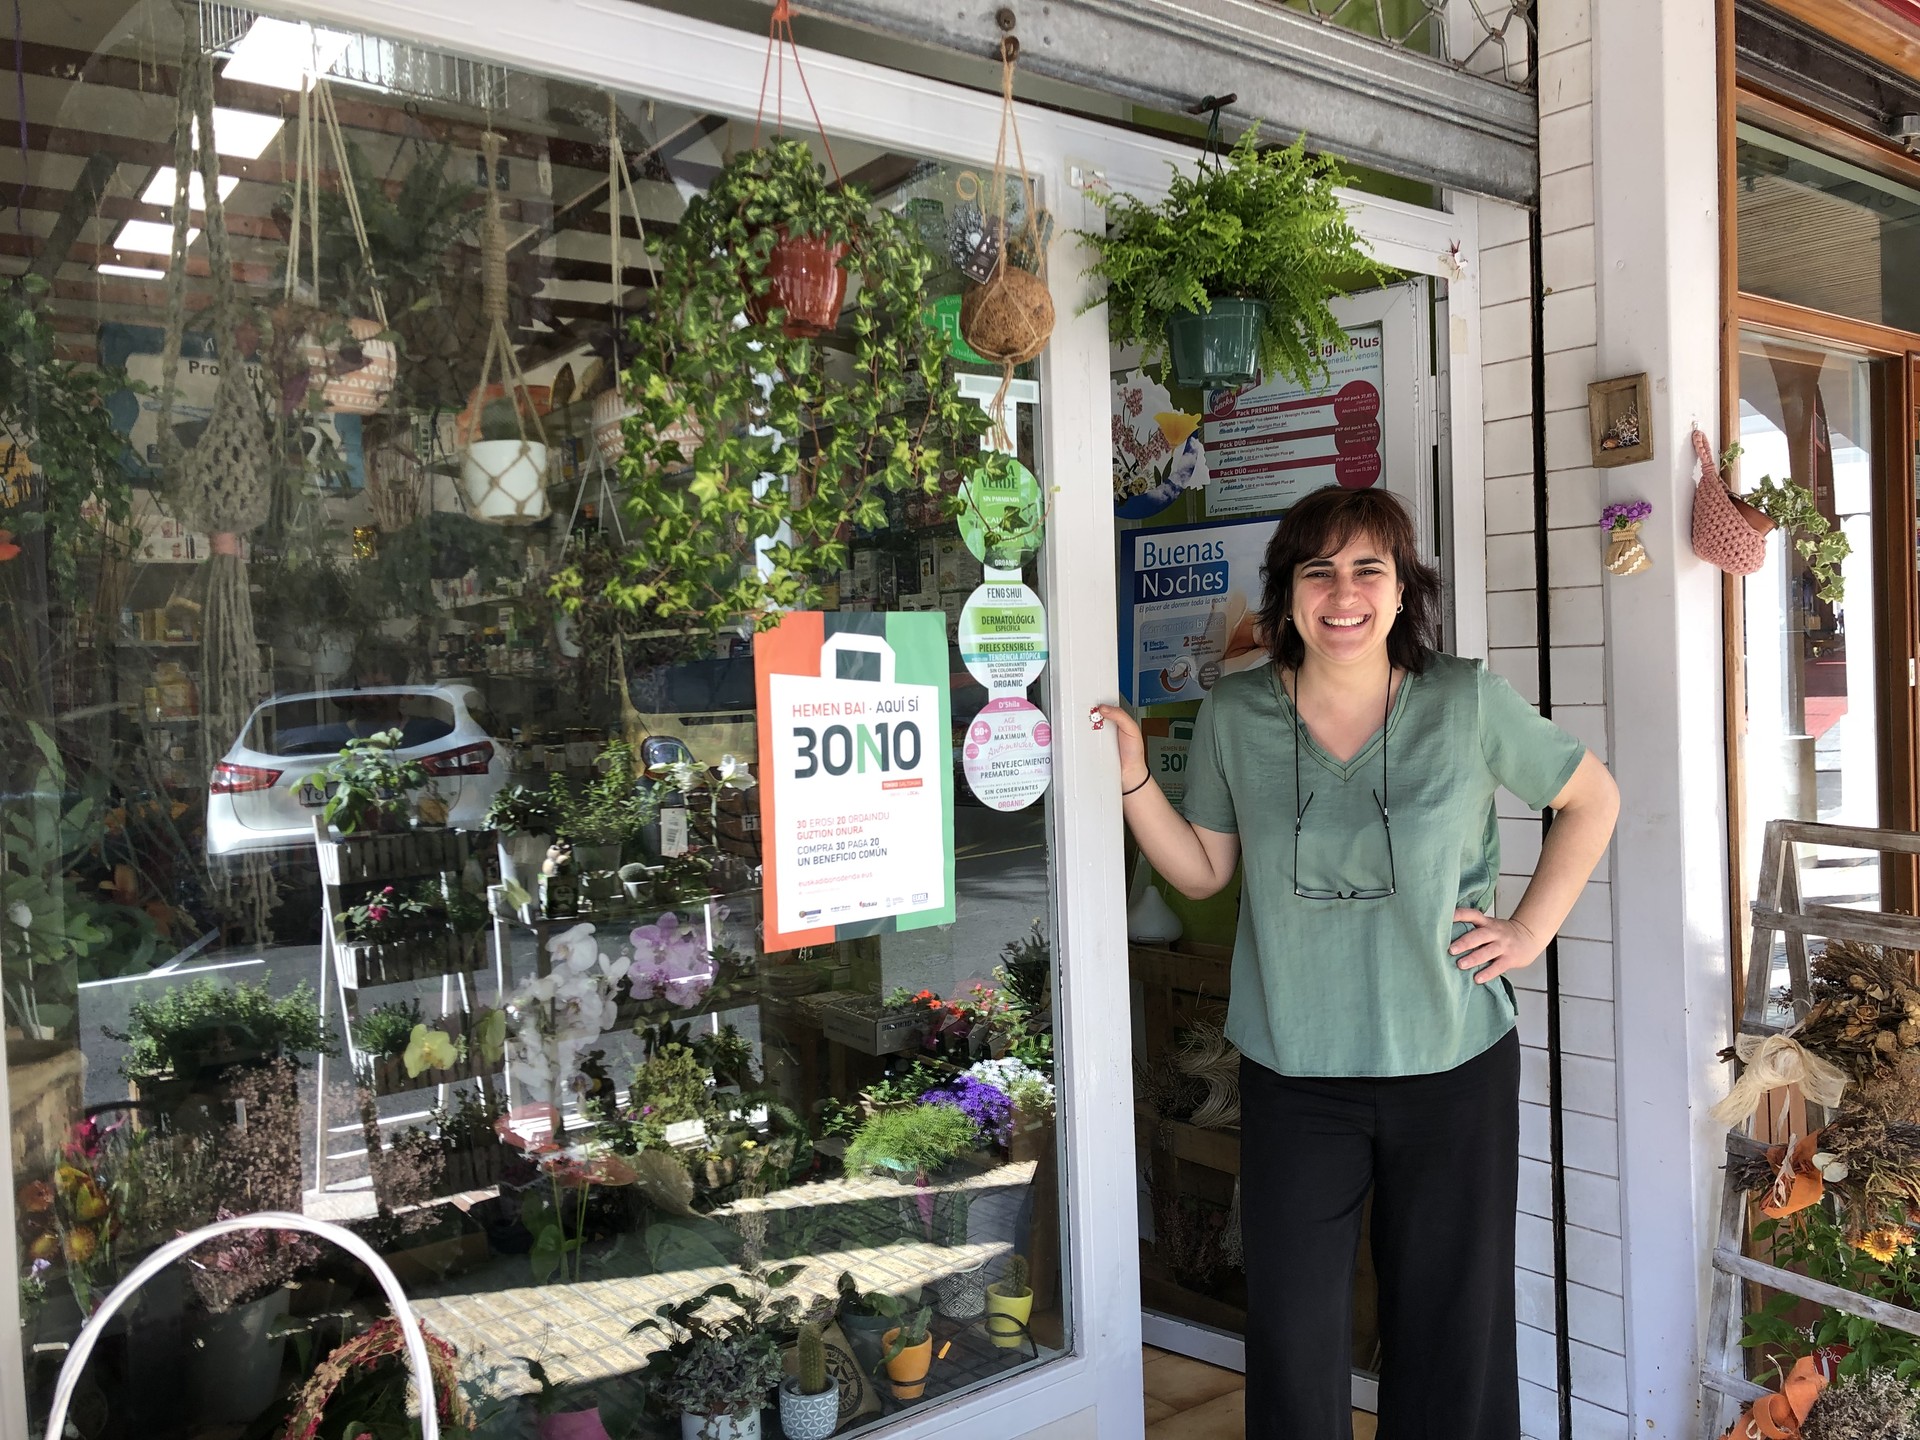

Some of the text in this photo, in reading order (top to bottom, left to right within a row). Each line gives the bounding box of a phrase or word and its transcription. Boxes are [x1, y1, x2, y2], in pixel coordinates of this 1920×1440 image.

[1350, 337, 1380, 350] Plus
[1250, 406, 1279, 414] PREMIUM
[981, 476, 1018, 489] VERDE
[1143, 540, 1224, 568] Buenas
[1142, 567, 1224, 598] Noches
[987, 588, 1022, 598] FENG SHUI
[1145, 604, 1161, 614] placer
[981, 614, 1035, 624] DERMATOLÓGICA
[1183, 636, 1190, 647] 2
[979, 642, 1034, 652] PIELES SENSIBLES
[1143, 642, 1148, 652] 1
[994, 680, 1022, 688] ORGANIC
[792, 696, 919, 717] HEMEN BAI AQUÍ SÍ
[974, 728, 988, 736] 50+
[991, 757, 1050, 770] ENVEJECIMIENTO
[980, 769, 1019, 779] PREMATURO
[996, 785, 1038, 794] CONSERVANTES
[998, 800, 1024, 808] ORGANIC
[797, 812, 889, 828] 30 EROSI 20 ORDAINDU
[797, 826, 863, 840] GUZTION ONURA
[798, 837, 879, 855] COMPRA 30 PAGA 20
[798, 846, 887, 866] UN BENEFICIO COMÚN
